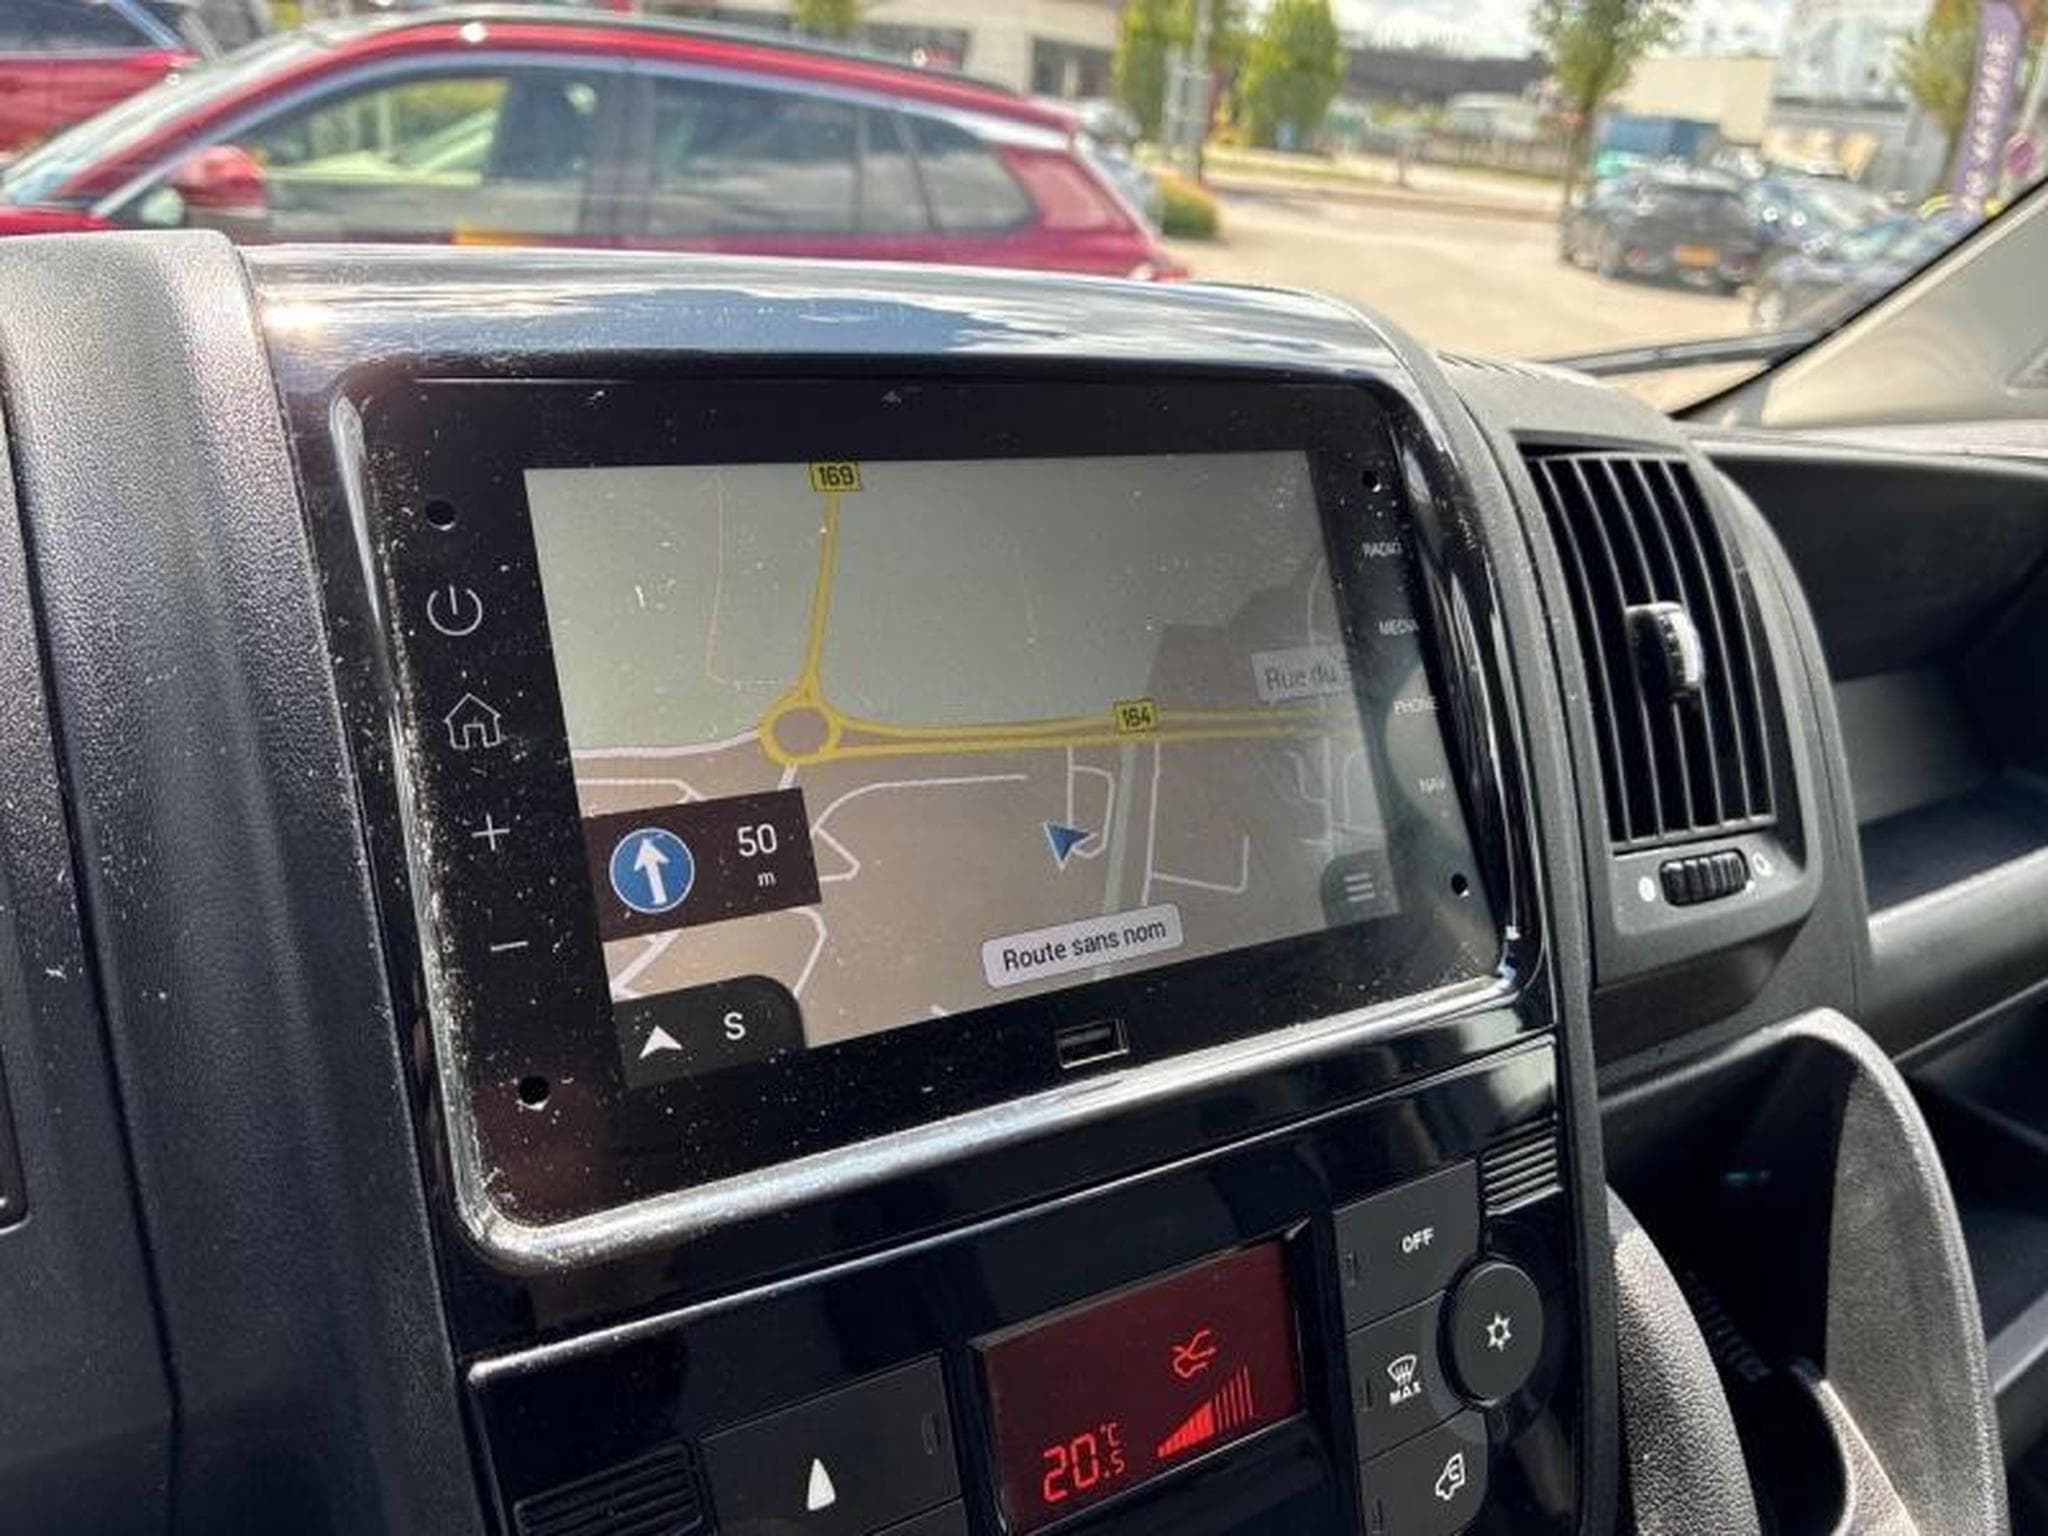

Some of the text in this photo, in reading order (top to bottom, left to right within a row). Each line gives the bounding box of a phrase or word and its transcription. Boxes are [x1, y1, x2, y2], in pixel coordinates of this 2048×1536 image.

[819, 464, 854, 486] 169
[1263, 667, 1307, 690] Rue
[737, 823, 777, 857] 50
[757, 871, 776, 887] m
[1002, 920, 1167, 973] Route sans nom
[723, 1011, 746, 1040] S
[1402, 1227, 1434, 1253] OFF
[1389, 1381, 1421, 1406] MAX
